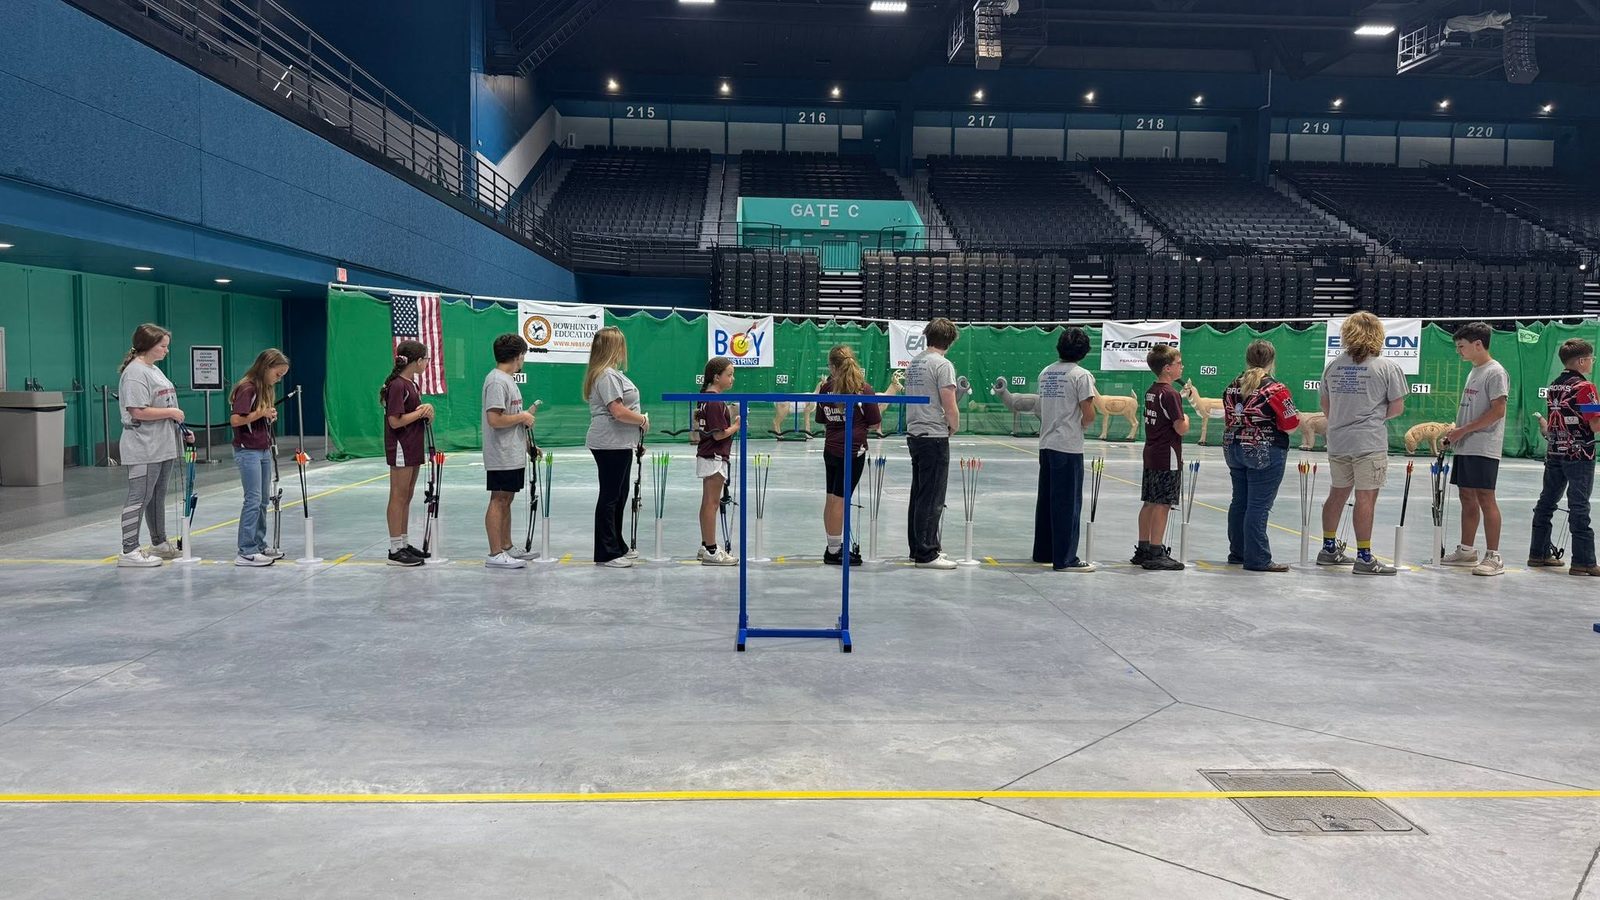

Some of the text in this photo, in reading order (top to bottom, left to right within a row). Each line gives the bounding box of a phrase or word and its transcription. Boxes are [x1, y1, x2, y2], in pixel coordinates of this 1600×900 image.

[626, 106, 655, 118] 215
[798, 111, 826, 123] 216
[968, 115, 996, 127] 217
[1136, 118, 1164, 130] 218
[1302, 122, 1330, 133] 219
[1466, 126, 1493, 138] 220
[791, 203, 860, 218] GATE C
[552, 322, 599, 331] BOWHUNTER
[1328, 336, 1418, 348] EON
[1201, 366, 1216, 375] 509
[1305, 381, 1321, 389] 510
[1412, 384, 1429, 393] 511
